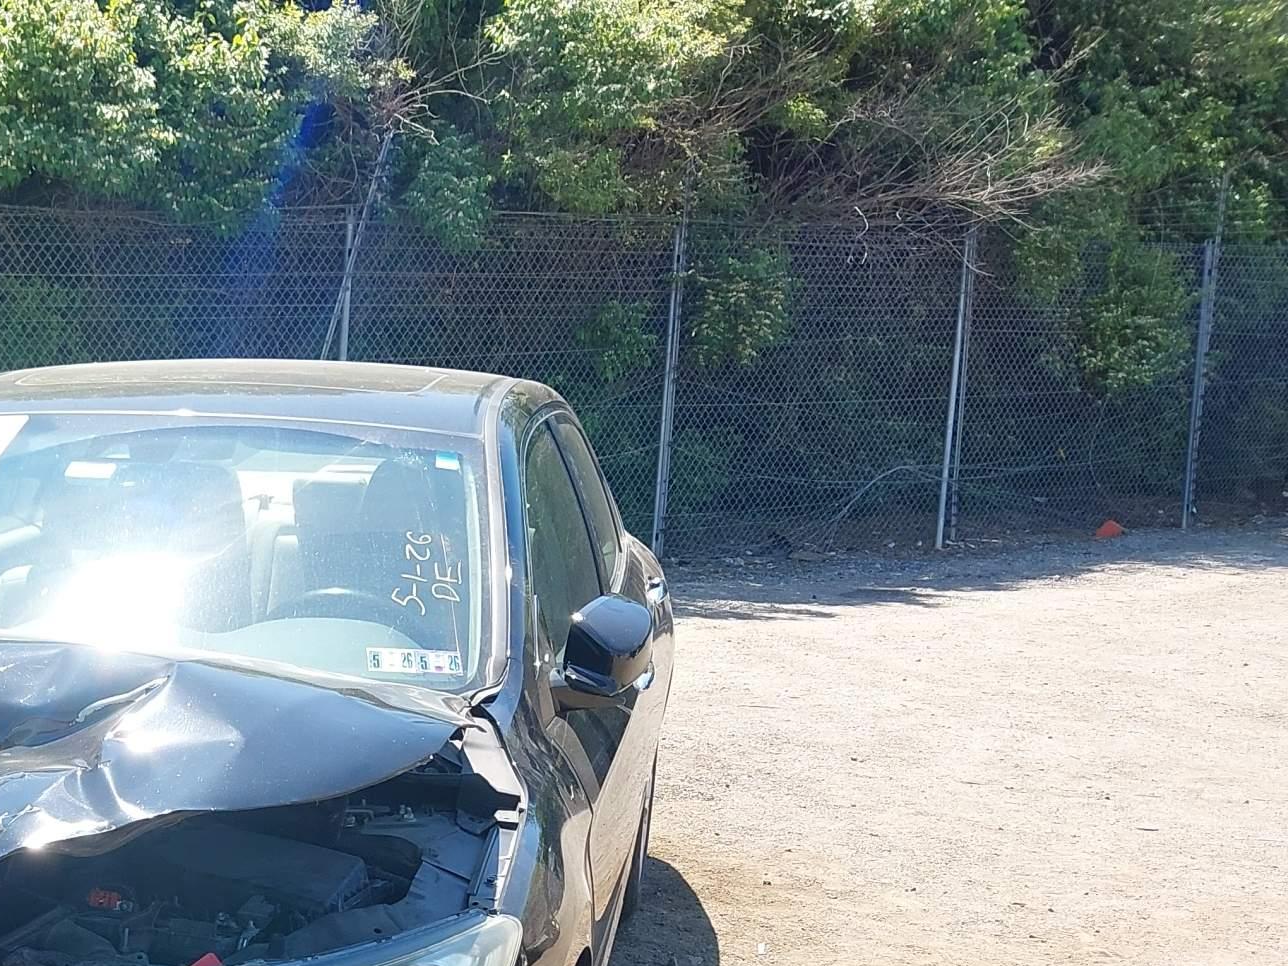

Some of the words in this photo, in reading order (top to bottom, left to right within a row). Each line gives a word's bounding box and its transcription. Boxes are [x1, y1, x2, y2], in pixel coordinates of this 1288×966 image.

[391, 531, 432, 616] 5-1-26
[372, 654, 380, 669] 5
[419, 655, 428, 670] 5
